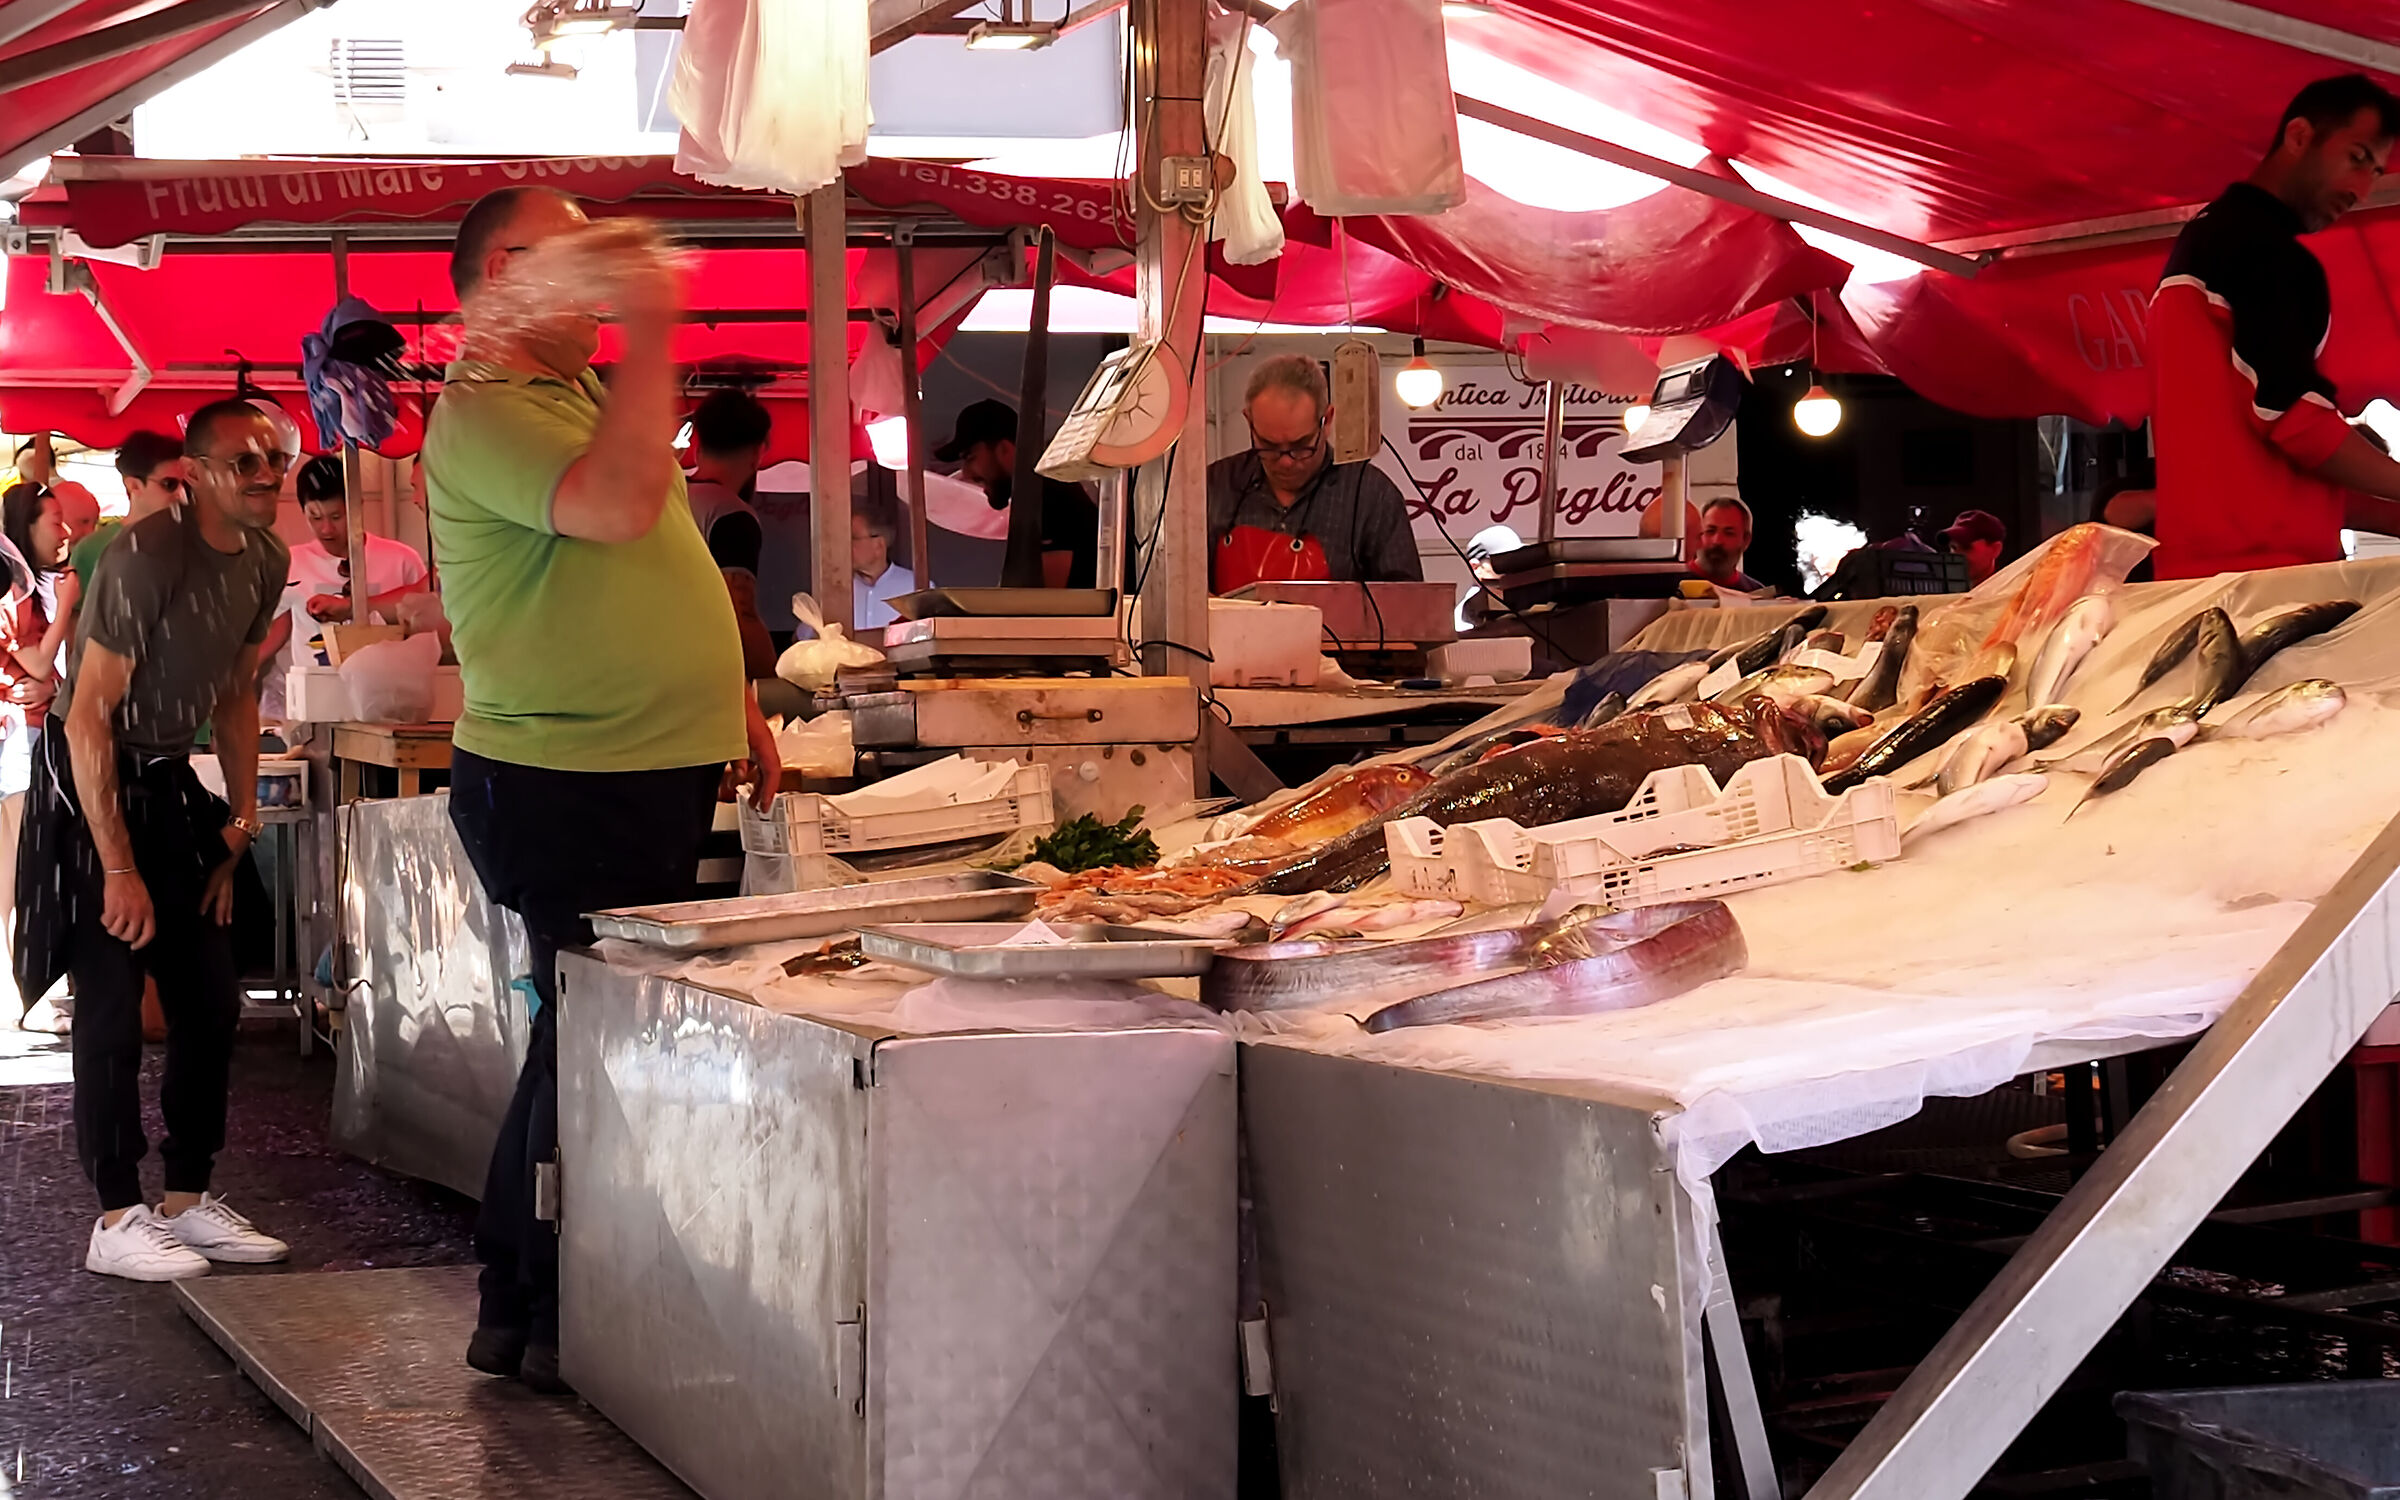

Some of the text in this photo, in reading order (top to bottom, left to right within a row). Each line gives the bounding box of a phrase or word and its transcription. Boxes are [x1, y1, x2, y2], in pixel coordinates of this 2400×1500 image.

[145, 177, 268, 219] Frutti
[336, 167, 444, 198] Mare
[1409, 383, 1510, 411] ntica
[1454, 442, 1569, 461] dal 184
[1404, 467, 1480, 525] La
